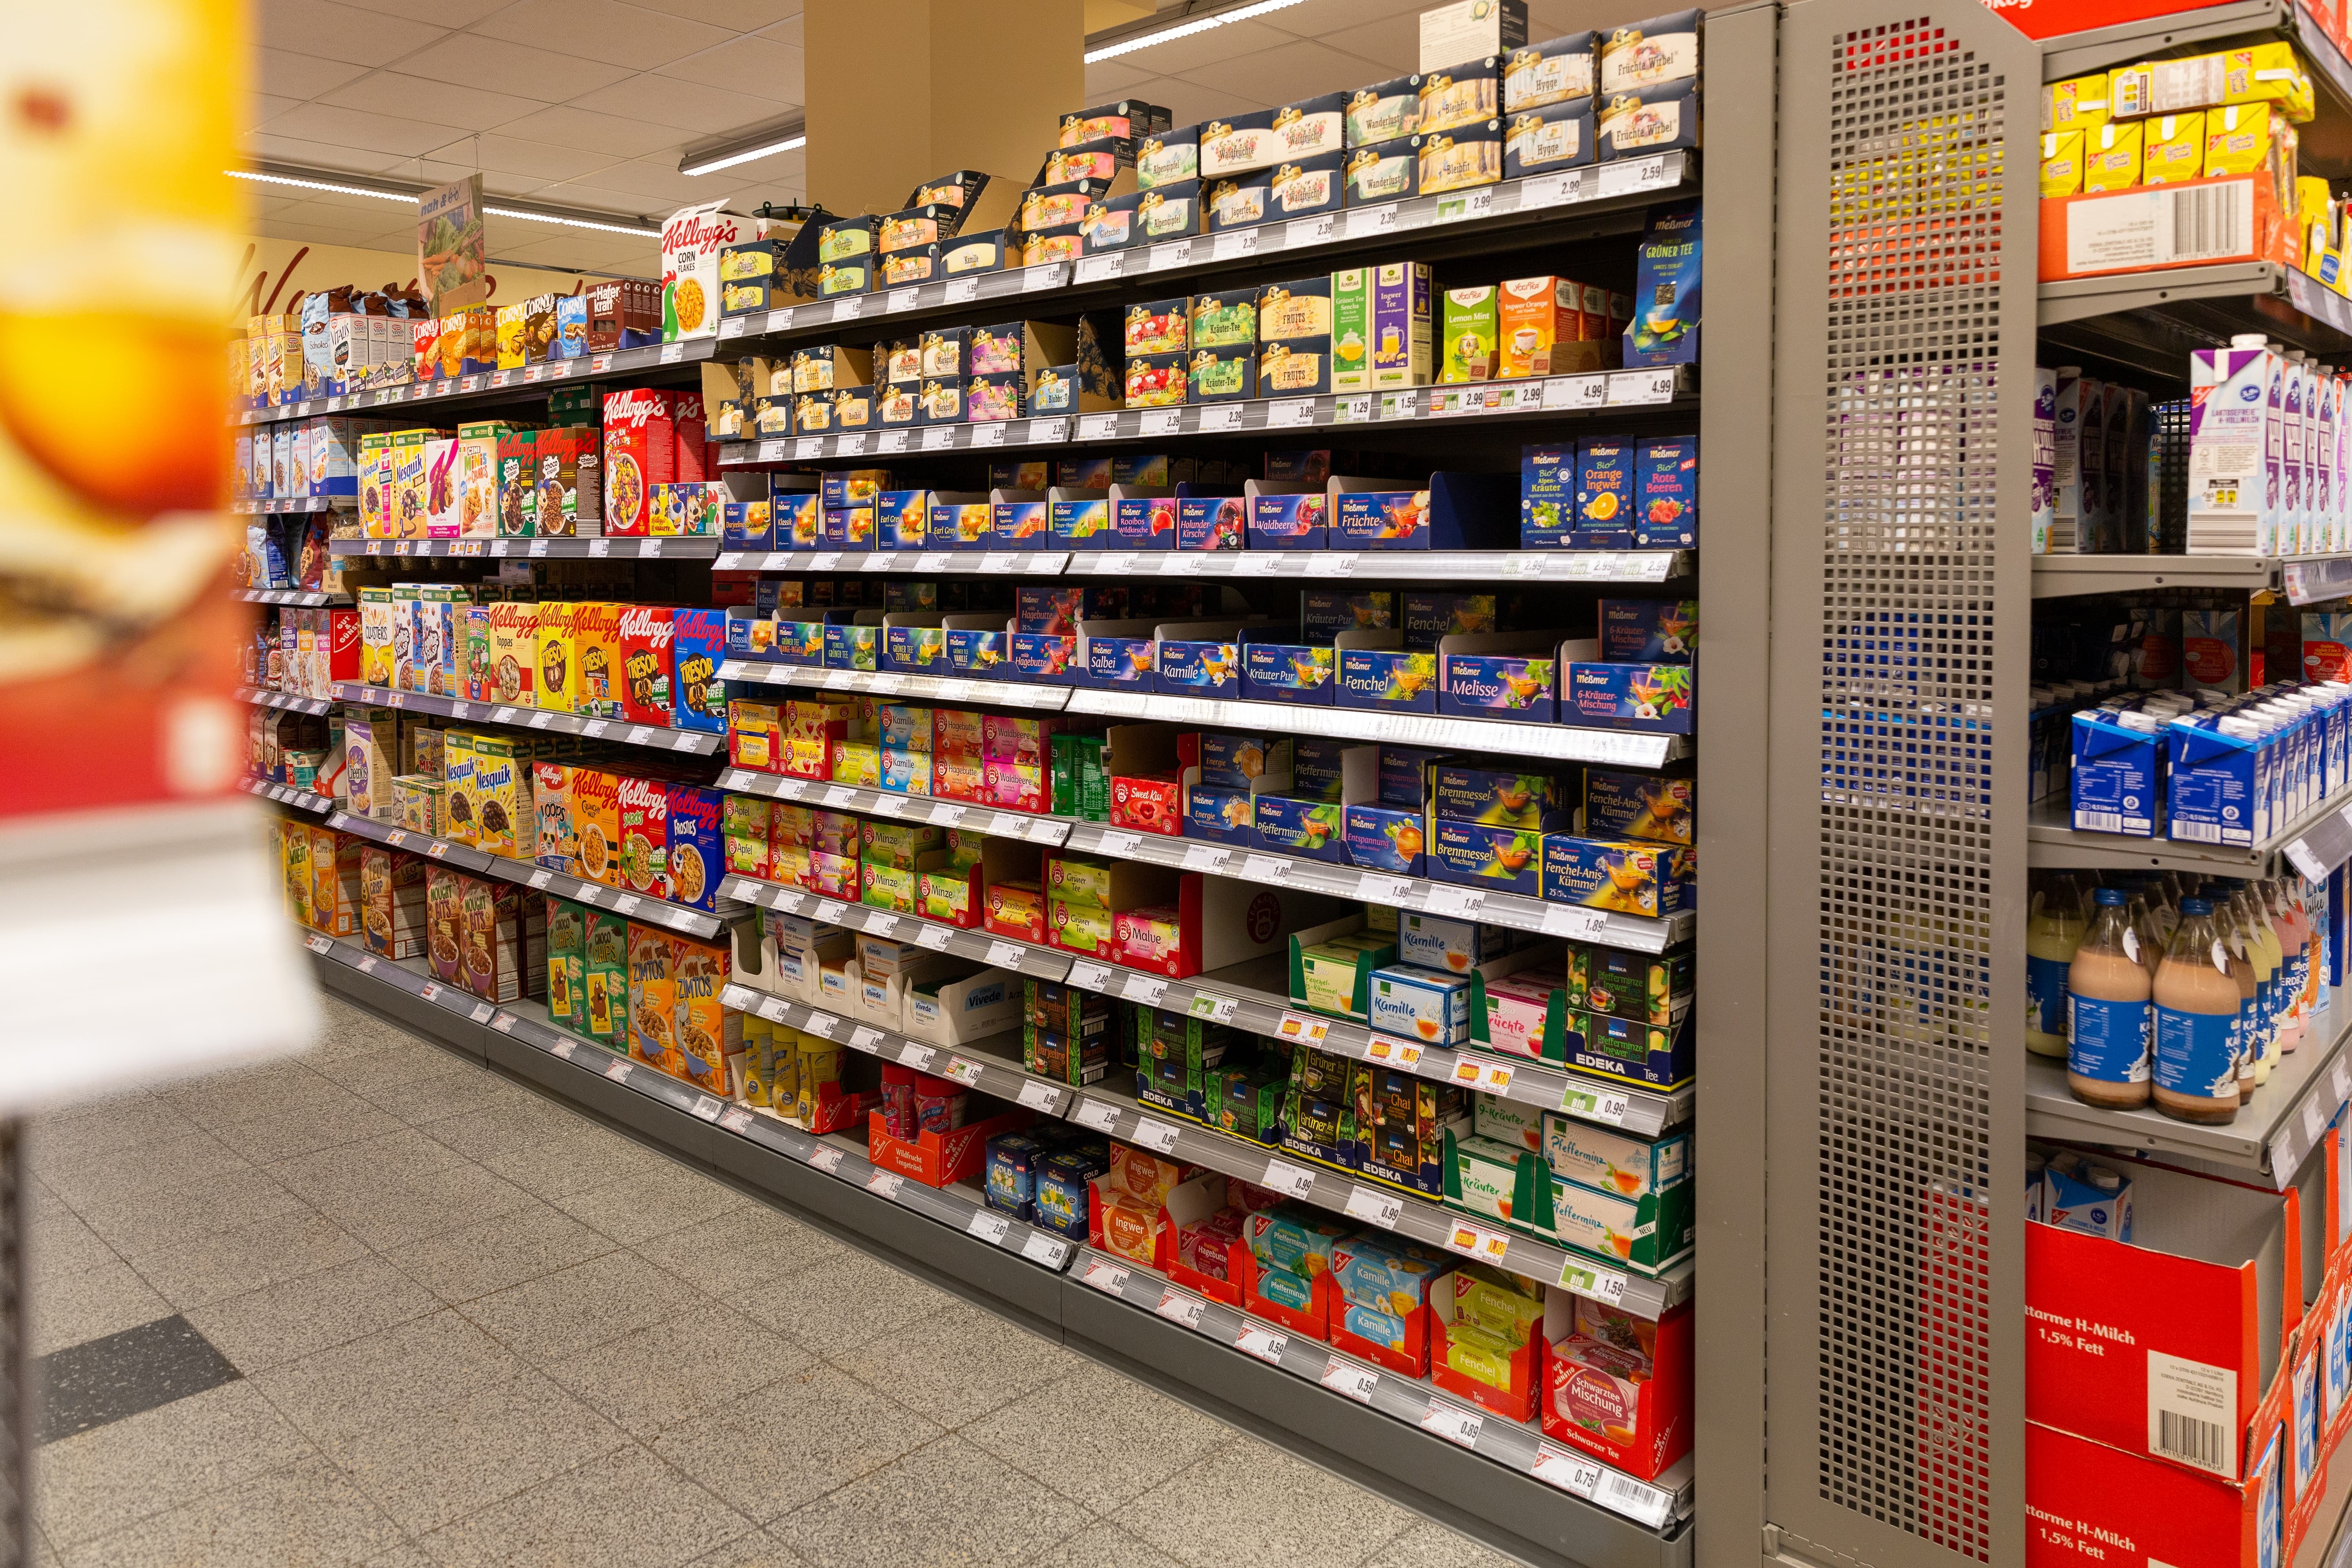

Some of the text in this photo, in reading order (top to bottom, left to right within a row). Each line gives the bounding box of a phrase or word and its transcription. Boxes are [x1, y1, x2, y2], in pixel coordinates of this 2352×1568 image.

[1618, 55, 1674, 75] Früchte Wirbel
[1536, 78, 1557, 91] Hygge
[1446, 100, 1467, 113] Bleibfit
[1366, 114, 1400, 130] Wanderlust
[1153, 159, 1180, 174] Alpengipfel
[1642, 166, 1661, 180] 2.59
[1045, 206, 1065, 216] Apfelernte
[1231, 206, 1251, 218] Jägertee
[890, 227, 925, 242] Hagebuttenmischung
[1100, 227, 1120, 238] Gletscher
[1318, 223, 1332, 234] 2.39
[662, 216, 738, 255] Kellogg's
[678, 251, 696, 263] CORN
[1177, 249, 1190, 260] 2.99
[1646, 243, 1692, 258] GRÜNER TEE
[678, 263, 695, 273] FLAKES
[908, 294, 917, 303] 1.59
[1505, 302, 1524, 310] Ingwer
[1283, 312, 1305, 324] FRUITS
[1449, 312, 1490, 323] Lemon Mint
[1210, 323, 1240, 334] Kräuter-Tee
[1652, 380, 1671, 393] 4.99
[1467, 393, 1483, 406] 2.99
[1500, 394, 1513, 406] BIO
[604, 391, 668, 426] Kellogg's
[1299, 406, 1313, 418] 3.89
[1353, 402, 1368, 414] 1.29
[1167, 416, 1179, 427] 2.39
[1533, 456, 1560, 464] Meßmer
[1681, 461, 1694, 470] NEU
[397, 454, 422, 484] Nesquik
[1586, 470, 1622, 480] Orange
[1652, 474, 1675, 483] Rote
[1532, 484, 1560, 492] Kräuter
[1587, 480, 1621, 491] Ingwer
[1647, 483, 1682, 492] Beeren
[1181, 521, 1211, 530] Holunder-
[1256, 520, 1294, 530] Waldbeere
[1343, 515, 1383, 526] Früchte-
[1183, 529, 1205, 538] Kirsche
[1347, 527, 1373, 536] Mischung
[366, 627, 387, 640] CLUSTERS
[497, 636, 513, 648] Toppas
[896, 653, 911, 661] ZITRONE
[1091, 656, 1115, 668] Salbei
[627, 653, 658, 679] TRESOR
[680, 658, 714, 682] TRESOR
[1163, 665, 1198, 679] Kamille
[1346, 661, 1371, 670] Meßmer
[1453, 666, 1480, 676] Meßmer
[1250, 669, 1294, 681] Kräuter Pur
[652, 683, 667, 692] FREE
[1345, 676, 1388, 692] Fenchel
[1453, 680, 1498, 697] Melisse
[1578, 690, 1617, 700] 6-Kräuter-
[893, 759, 914, 769] Kamille
[949, 765, 977, 776] Hagebutte
[476, 764, 511, 792] Nesquik
[1000, 773, 1032, 785] Waldbeere
[1131, 788, 1162, 801] Sweet Kiss
[674, 819, 695, 836] FROSTIES
[1348, 834, 1389, 848] Entspannung
[737, 844, 752, 855] Apfel
[1438, 844, 1495, 862] Brennnessel-
[1449, 857, 1476, 868] Mischung
[1546, 863, 1605, 880] Fenchel-Anis-
[1558, 874, 1598, 891] Kümmel
[431, 885, 452, 900] NOUGAT
[931, 886, 953, 898] Minze
[436, 900, 451, 920] BITS
[1463, 898, 1481, 910] 1.89
[1133, 928, 1161, 944] Malve
[1405, 933, 1445, 950] Kamille
[594, 944, 616, 964] CHIPS
[1598, 971, 1643, 986] Pfefferminze
[678, 978, 712, 998] ZIMTOS
[1151, 986, 1164, 999] 1.99
[969, 990, 1001, 1007] Vivede
[1375, 997, 1415, 1017] Kamille
[1038, 1044, 1065, 1063] Darjeeling
[1370, 1043, 1390, 1057] WERBUNG
[1401, 1049, 1417, 1062] 0.88
[1311, 1054, 1336, 1071] Grüner
[1644, 1068, 1658, 1081] Tee
[1143, 1091, 1173, 1107] EDEKA
[1391, 1093, 1410, 1110] Chai
[1571, 1098, 1585, 1109] BIO
[1605, 1100, 1624, 1115] 0.99
[1479, 1104, 1525, 1125] 9-Kräuter
[1285, 1138, 1321, 1157] EDEKA
[1551, 1136, 1607, 1164] Pfefferminz
[896, 1148, 922, 1163] Wildfrucht
[1336, 1153, 1346, 1165] Tee
[896, 1157, 923, 1172] Teegetränk
[1363, 1162, 1402, 1182] EDEKA
[1045, 1182, 1064, 1194] COLD
[1417, 1179, 1428, 1190] Tee
[1116, 1217, 1144, 1234] Ingwer
[1638, 1226, 1651, 1235] NEU
[1198, 1242, 1227, 1262] Hagebutte
[1271, 1282, 1306, 1299] Pfefferminze
[1604, 1279, 1623, 1296] 1.59
[2076, 1317, 2135, 1345] H-Milch
[1268, 1340, 1284, 1355] 0.59
[2039, 1328, 2105, 1356] 1,5% Fett
[1460, 1355, 1495, 1377] Fenchel
[1576, 1377, 1620, 1402] Schwarztee
[1571, 1385, 1622, 1417] Mischung
[1461, 1421, 1478, 1438] 0.89
[1567, 1428, 1619, 1459] Schwarzer Tee
[1575, 1470, 1595, 1487] 0.75
[2076, 1521, 2135, 1552] H-Milch
[2040, 1528, 2105, 1560] 1,5% Fett
